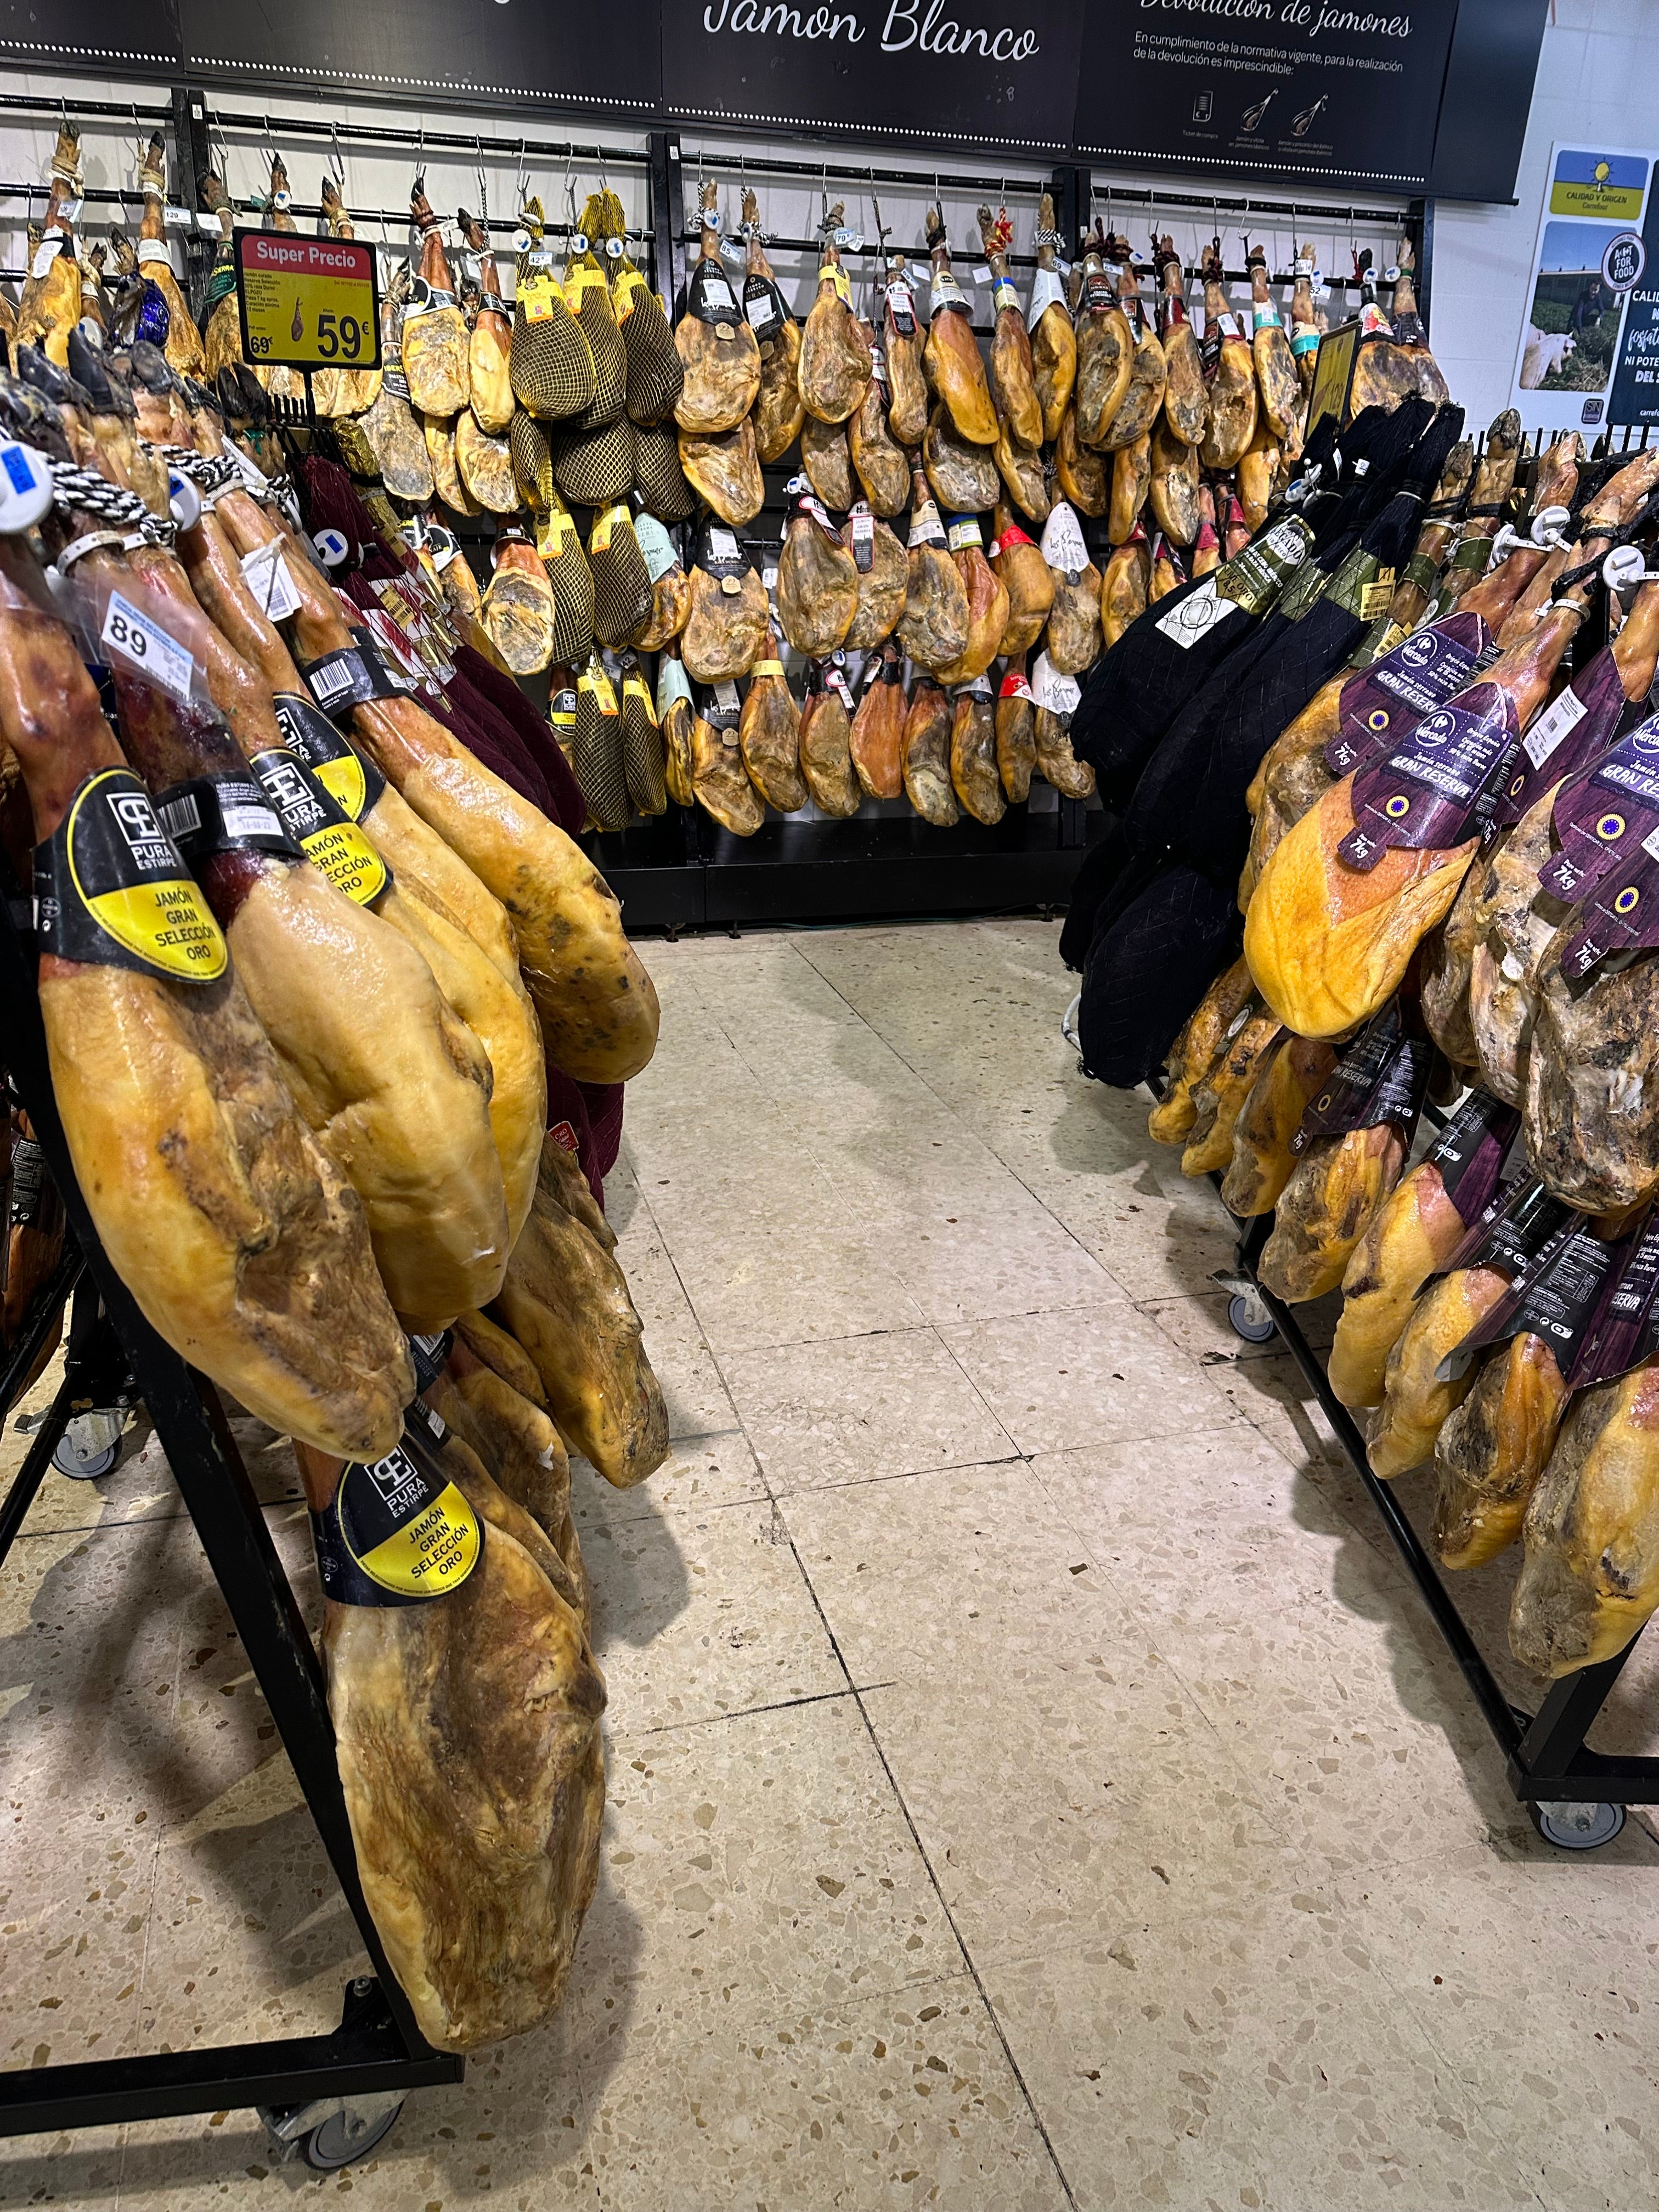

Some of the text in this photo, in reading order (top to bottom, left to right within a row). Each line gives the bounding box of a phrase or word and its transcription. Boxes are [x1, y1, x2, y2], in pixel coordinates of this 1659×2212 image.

[1281, 0, 1413, 37] de jamones
[881, 0, 1039, 60] Blanco
[1133, 47, 1294, 75] de la devolución es imprescindible:
[1135, 30, 1403, 72] En cumplimiento de la normativa vigente, para la realización
[1566, 191, 1594, 200] CALIDAD
[1602, 195, 1628, 204] ORIGEN
[837, 234, 846, 243] 79
[256, 241, 357, 268] Super Precio
[721, 245, 731, 255] 85
[1052, 261, 1062, 269] 69
[1614, 266, 1634, 279] FOOD
[1616, 257, 1632, 268] FOR
[1310, 286, 1321, 295] 52
[1624, 357, 1635, 366] NI
[1635, 370, 1654, 382] DEL
[110, 614, 146, 657] 89
[1403, 645, 1429, 665] Mercado
[1377, 670, 1440, 713] GRAN RESERV
[1397, 670, 1437, 698] Jamón serrano
[1416, 725, 1448, 744] Mercado
[1635, 727, 1659, 746] Merca
[1335, 746, 1351, 766] 7kg
[1413, 752, 1460, 776] Jamón serrano
[1391, 755, 1423, 772] GRAN
[1419, 766, 1470, 797] RESERVA
[1601, 764, 1638, 786] GRAN
[1629, 759, 1655, 777] Jamón
[284, 800, 322, 823] URA
[131, 845, 173, 860] PURA
[306, 832, 344, 859] AMÓN
[1350, 838, 1369, 859] 7kg
[137, 857, 177, 871] ESTIRPE
[326, 855, 373, 883] ECCIÓN
[1563, 859, 1575, 869] Peso
[1553, 865, 1576, 890] 7kg
[155, 887, 193, 907] JAMÓN
[166, 909, 198, 925] GRAN
[154, 922, 216, 947] SELECCIÓN
[186, 944, 211, 961] ORO
[1575, 945, 1593, 970] 7kg
[1341, 1068, 1373, 1087] RESERVA
[1611, 1292, 1641, 1310] ESERVA
[386, 1477, 425, 1511] PURA
[392, 1483, 430, 1519] ESTIRPE
[409, 1506, 445, 1544] JAMÓN
[419, 1522, 451, 1553] GRAN
[411, 1523, 469, 1579] SELECCIÓN
[439, 1550, 463, 1575] ORO
